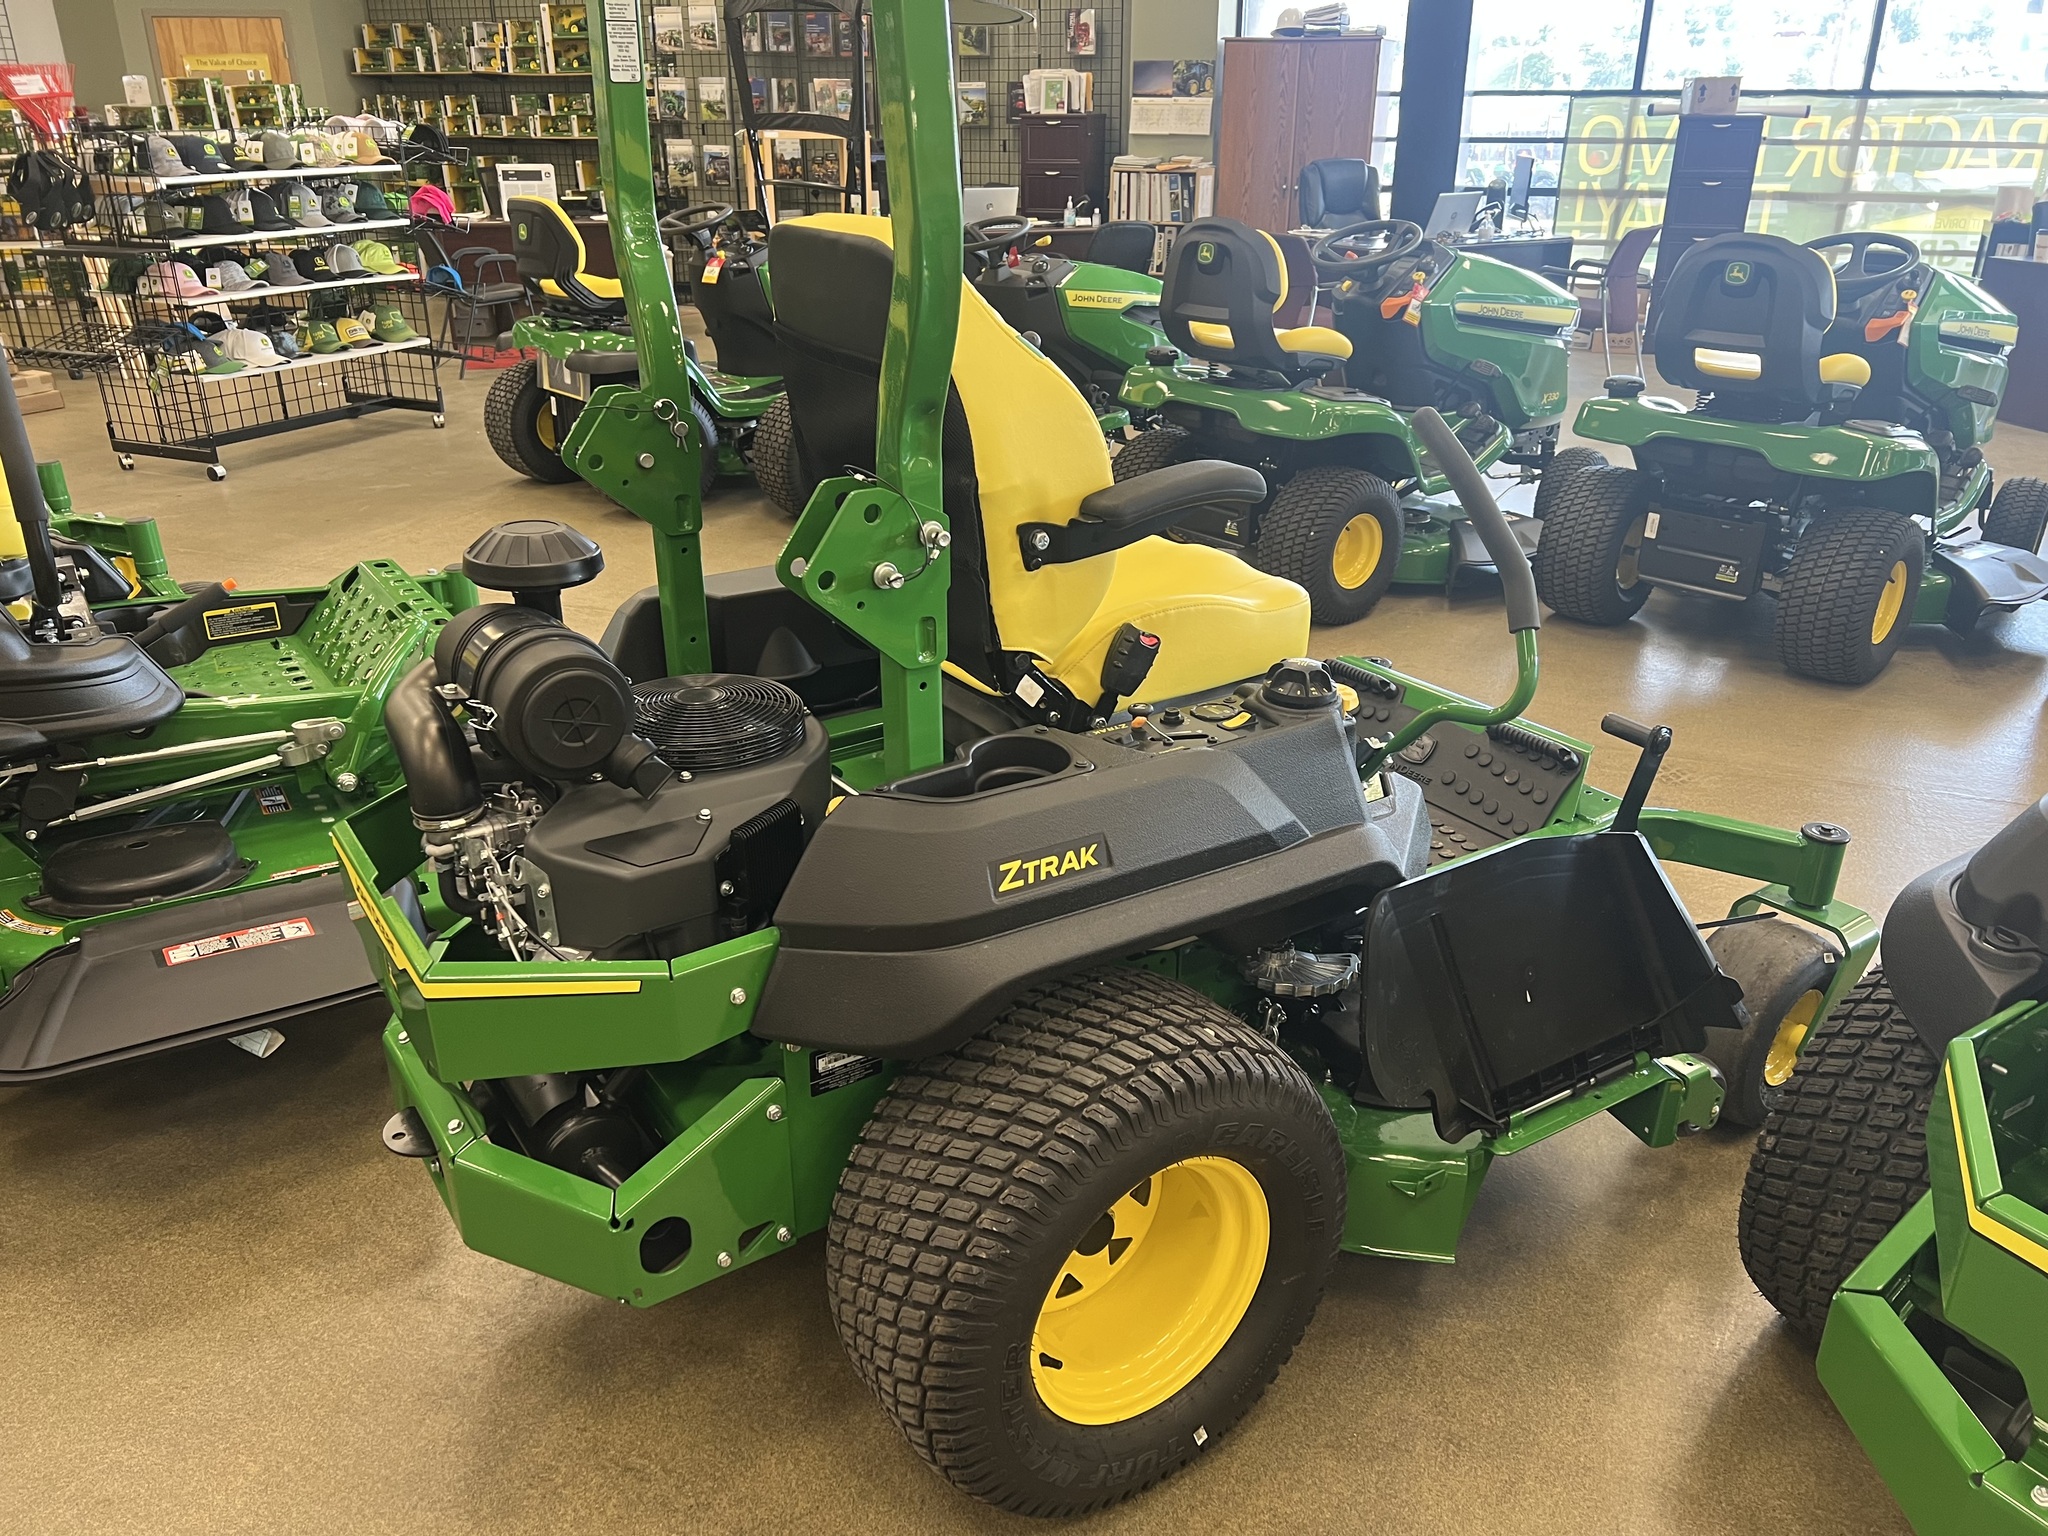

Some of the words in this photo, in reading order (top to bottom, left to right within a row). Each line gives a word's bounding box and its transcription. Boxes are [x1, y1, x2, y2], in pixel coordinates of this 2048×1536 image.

[195, 58, 208, 66] The
[228, 58, 235, 66] of
[236, 58, 257, 66] Choice
[1072, 293, 1095, 303] JOHN
[1096, 295, 1123, 304] DEERE
[1477, 305, 1499, 316] JOHN
[1500, 307, 1524, 319] DEERE
[1957, 323, 1973, 336] JOHN
[1973, 326, 1991, 338] DEERE
[1541, 391, 1560, 405] X330
[1400, 765, 1433, 786] DEERE
[998, 843, 1099, 893] ZTRAK
[1207, 1121, 1326, 1245] CARLISLE
[1001, 1342, 1080, 1488] MASTER
[1079, 1436, 1185, 1488] TURF
